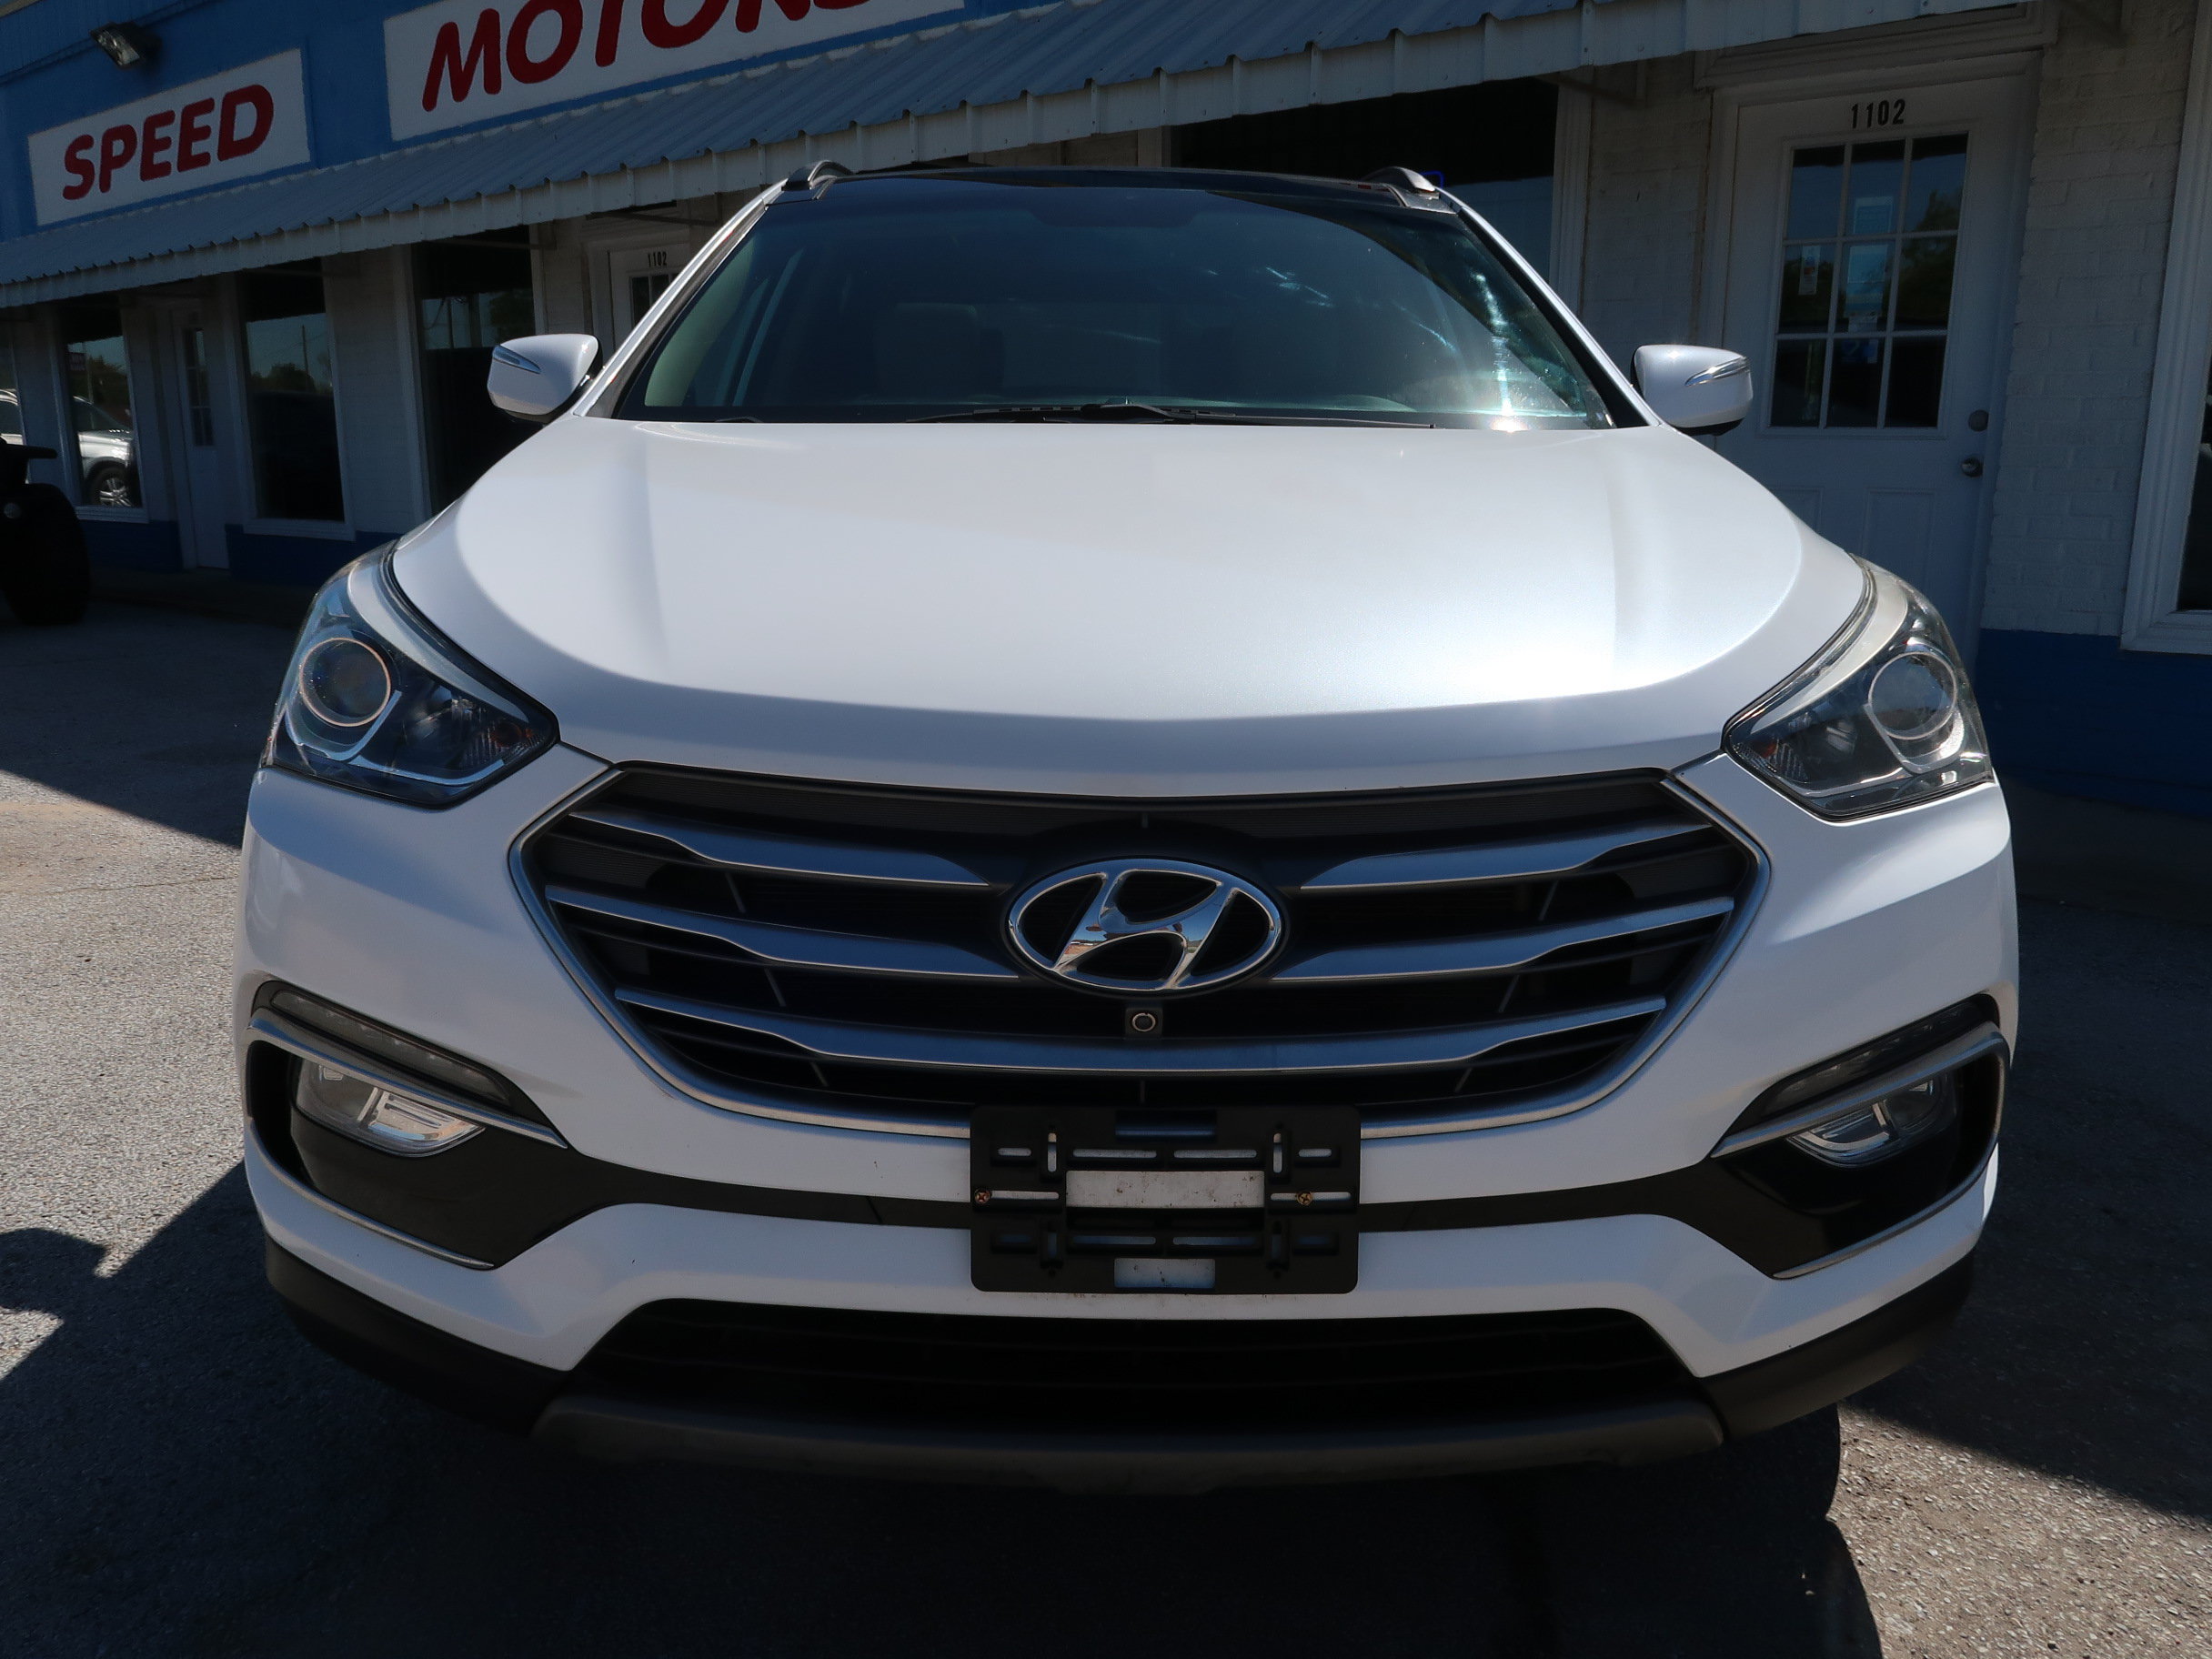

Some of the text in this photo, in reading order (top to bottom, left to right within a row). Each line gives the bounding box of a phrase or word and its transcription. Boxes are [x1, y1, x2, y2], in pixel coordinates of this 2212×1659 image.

[423, 0, 869, 111] MOTO
[62, 84, 275, 201] SPEED
[1851, 98, 1906, 129] 1102
[647, 250, 668, 267] 1102
